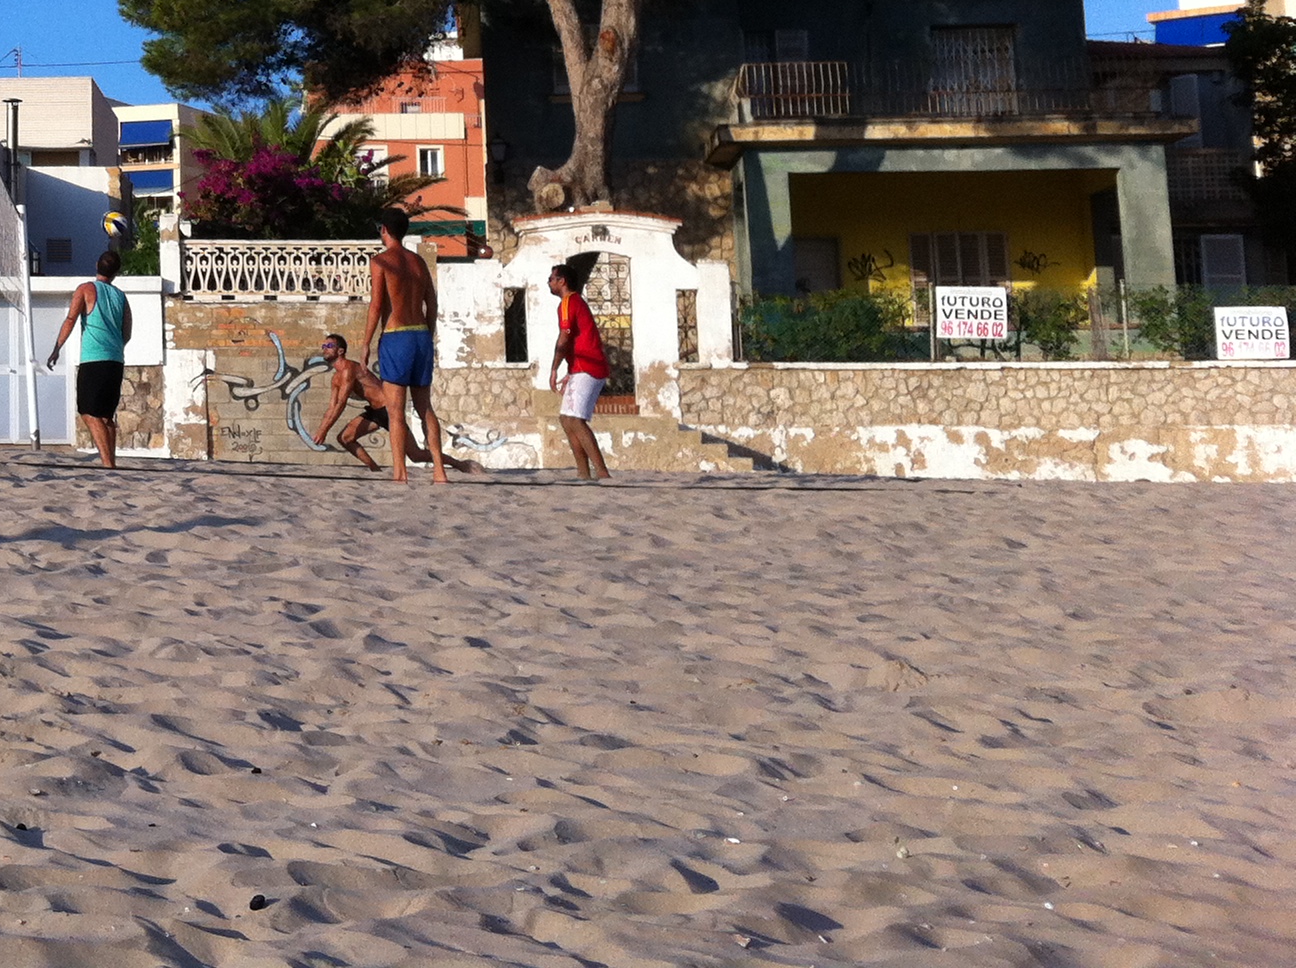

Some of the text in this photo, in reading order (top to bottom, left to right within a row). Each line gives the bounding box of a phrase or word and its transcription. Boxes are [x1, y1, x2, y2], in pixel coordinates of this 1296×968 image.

[575, 234, 622, 245] CARMEN
[942, 308, 1004, 321] VENDE
[941, 320, 1003, 338] 96 174 66 02
[1221, 329, 1286, 341] VENDE
[1221, 341, 1235, 357] 96
